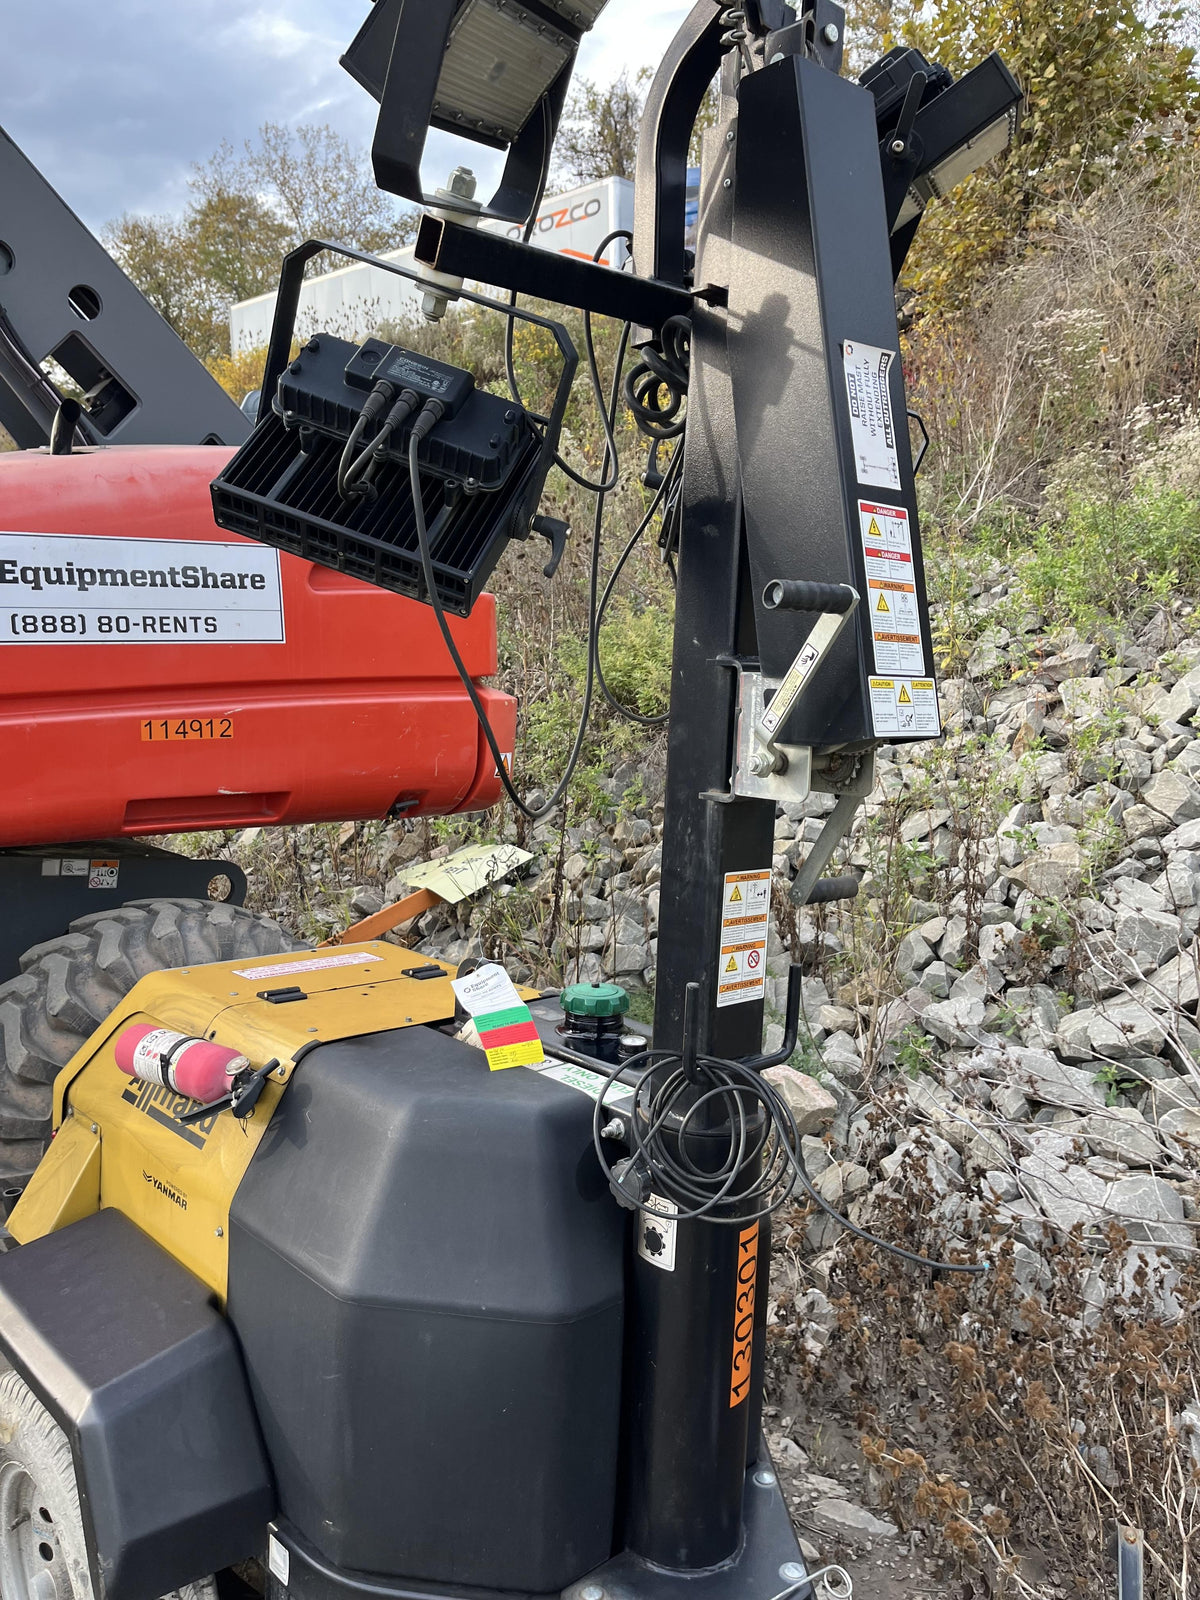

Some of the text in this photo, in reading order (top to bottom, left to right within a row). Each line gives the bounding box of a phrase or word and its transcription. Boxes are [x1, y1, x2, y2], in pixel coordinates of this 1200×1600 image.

[507, 198, 601, 241] OOZCO
[849, 375, 859, 416] DO NOT
[855, 365, 868, 427] RAISE MAST
[871, 371, 884, 429] EXTENDING
[880, 355, 893, 446] ALL OUTRIGGERS
[866, 391, 877, 437] WITHOUT
[876, 507, 897, 517] DANGER
[881, 551, 901, 560] DANGER
[0, 559, 266, 591] EquipmentShare
[883, 582, 905, 591] WARNING
[11, 614, 218, 635] (888) 80-RENTS
[144, 718, 233, 740] 114912
[736, 943, 756, 951] WARNING
[560, 1074, 601, 1094] DIESEL
[562, 1066, 600, 1081] ONLY
[153, 1176, 188, 1211] YANMAR
[732, 1231, 758, 1398] 130301
